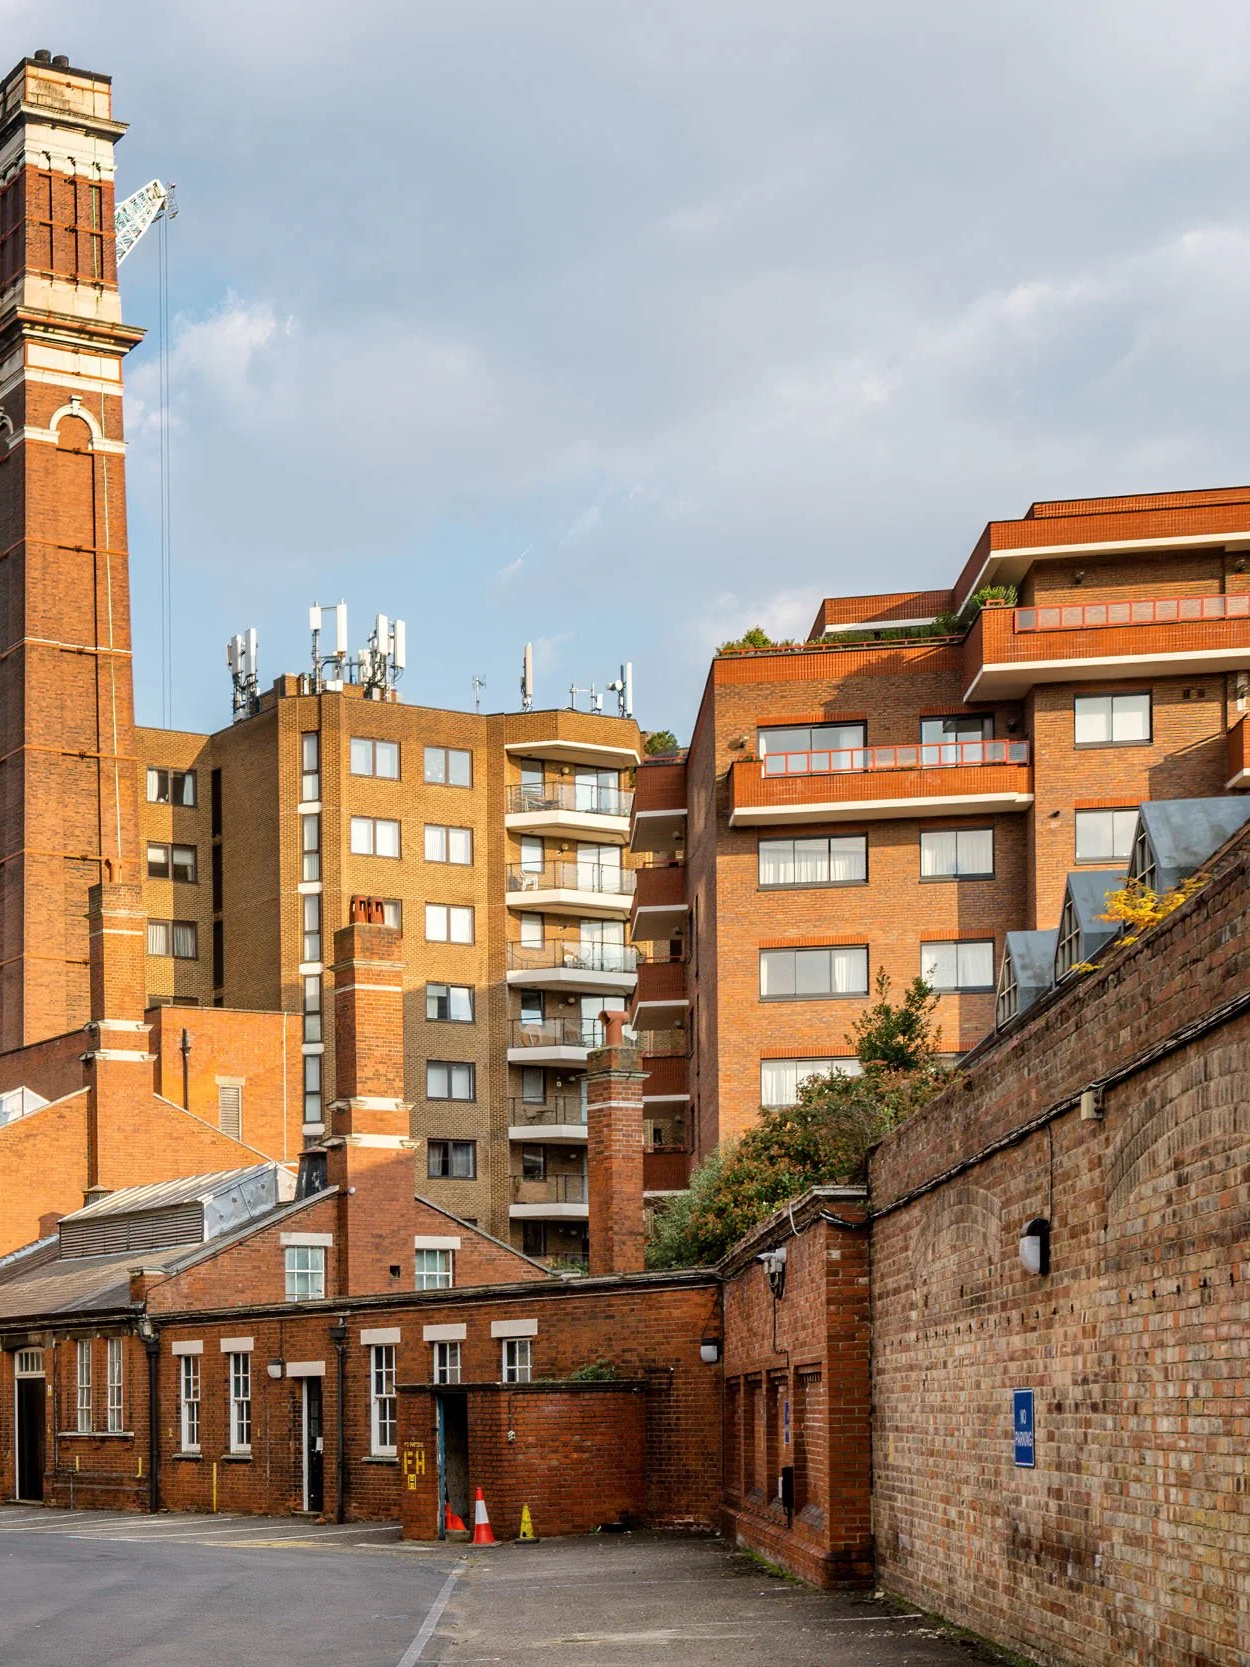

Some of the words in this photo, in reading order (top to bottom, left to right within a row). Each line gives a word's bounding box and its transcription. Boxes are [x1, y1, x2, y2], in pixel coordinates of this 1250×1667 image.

[1019, 1408, 1027, 1425] NO
[1015, 1431, 1032, 1447] PARKING
[403, 1451, 425, 1475] FH
